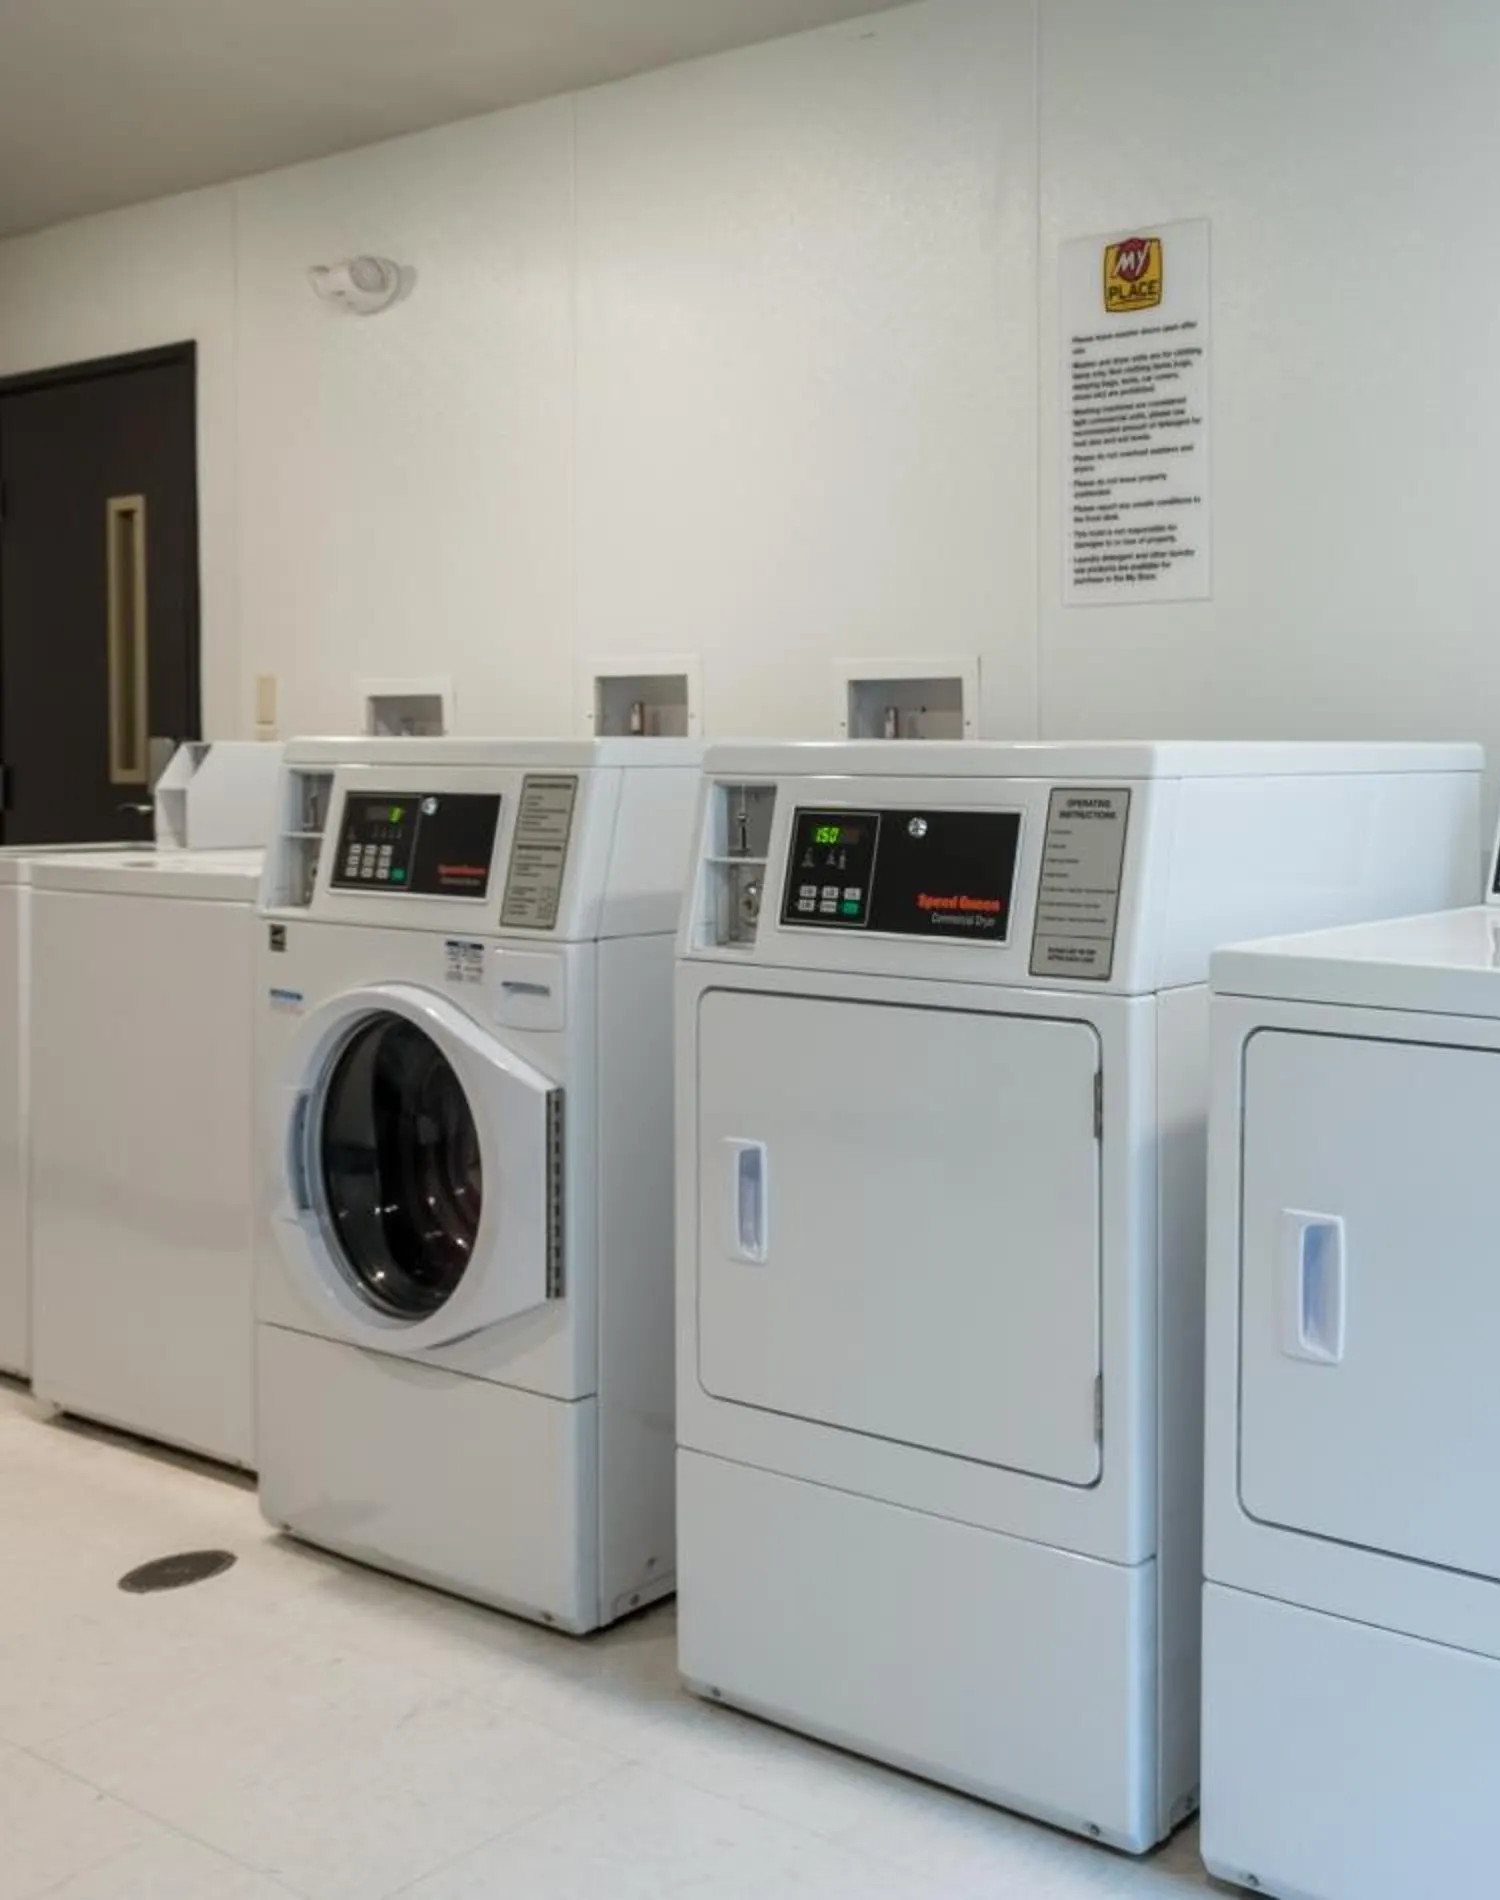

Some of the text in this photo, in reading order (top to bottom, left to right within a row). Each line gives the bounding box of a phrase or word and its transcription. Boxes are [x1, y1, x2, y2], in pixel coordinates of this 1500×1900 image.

[1113, 241, 1151, 276] MY
[1108, 279, 1157, 299] PLACE
[917, 892, 1000, 912] Speed Queen
[931, 911, 974, 926] Commercial
